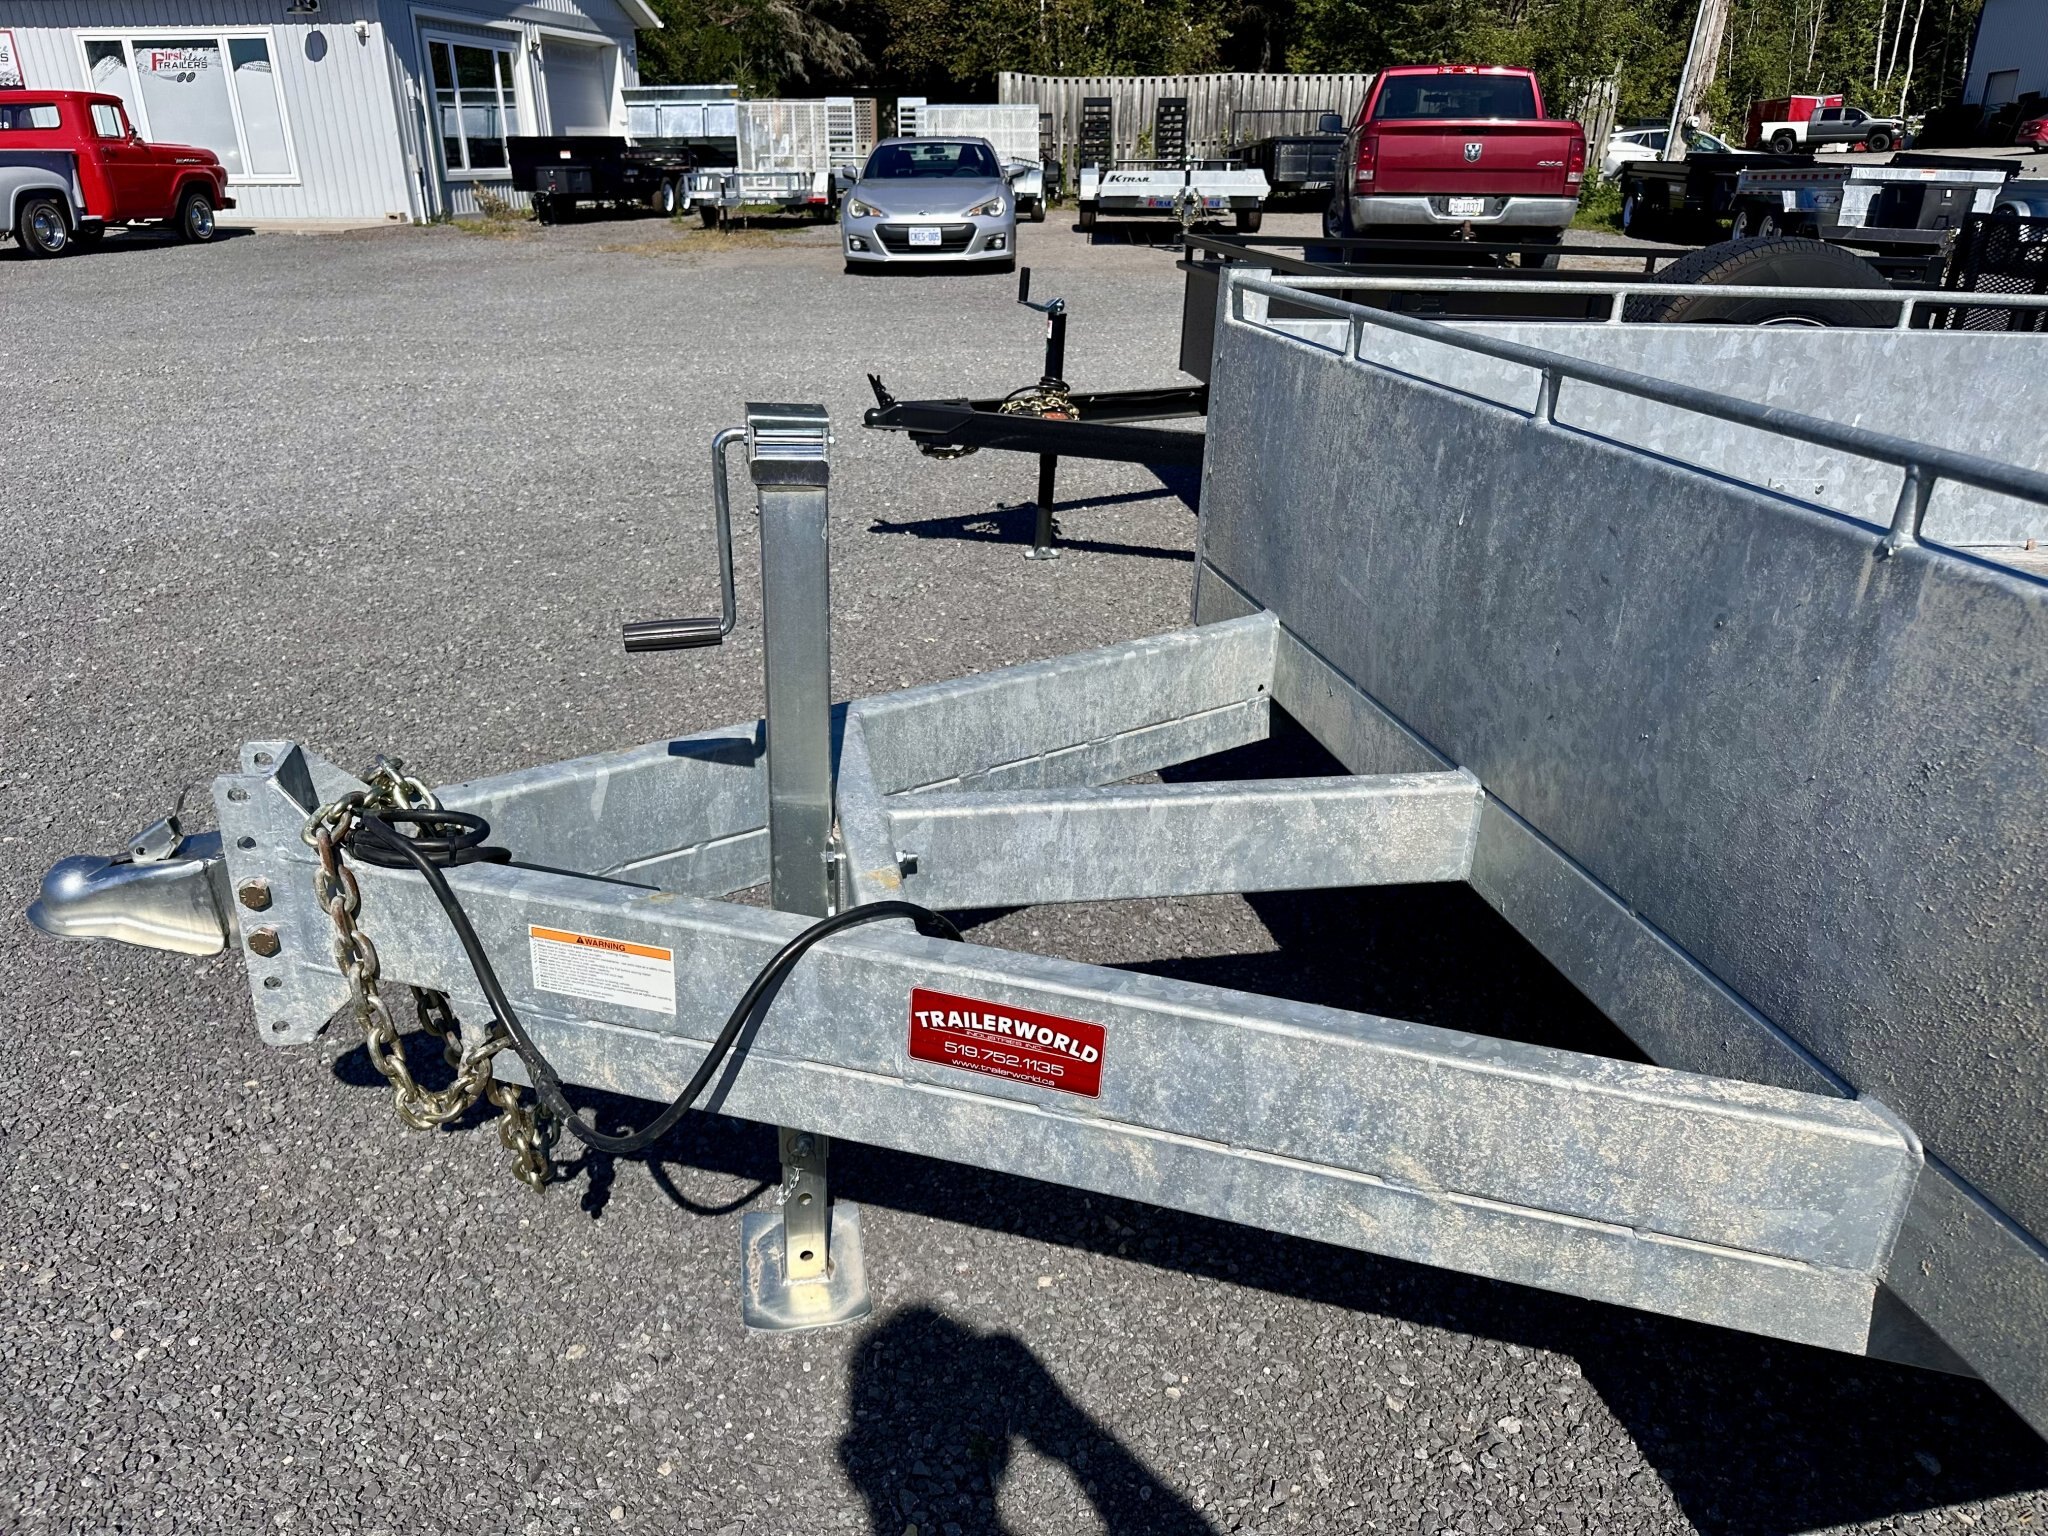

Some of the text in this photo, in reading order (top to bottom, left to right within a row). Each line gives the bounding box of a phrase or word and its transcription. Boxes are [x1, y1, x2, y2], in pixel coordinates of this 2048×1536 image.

[152, 51, 182, 71] First
[584, 938, 626, 952] WARNING
[915, 1011, 1099, 1063] TRAILERWORLD
[966, 1030, 1023, 1047] INDUSTRIES
[944, 1041, 1065, 1077] 519.752.1135
[952, 1058, 1056, 1087] www.trailerworld.ca
